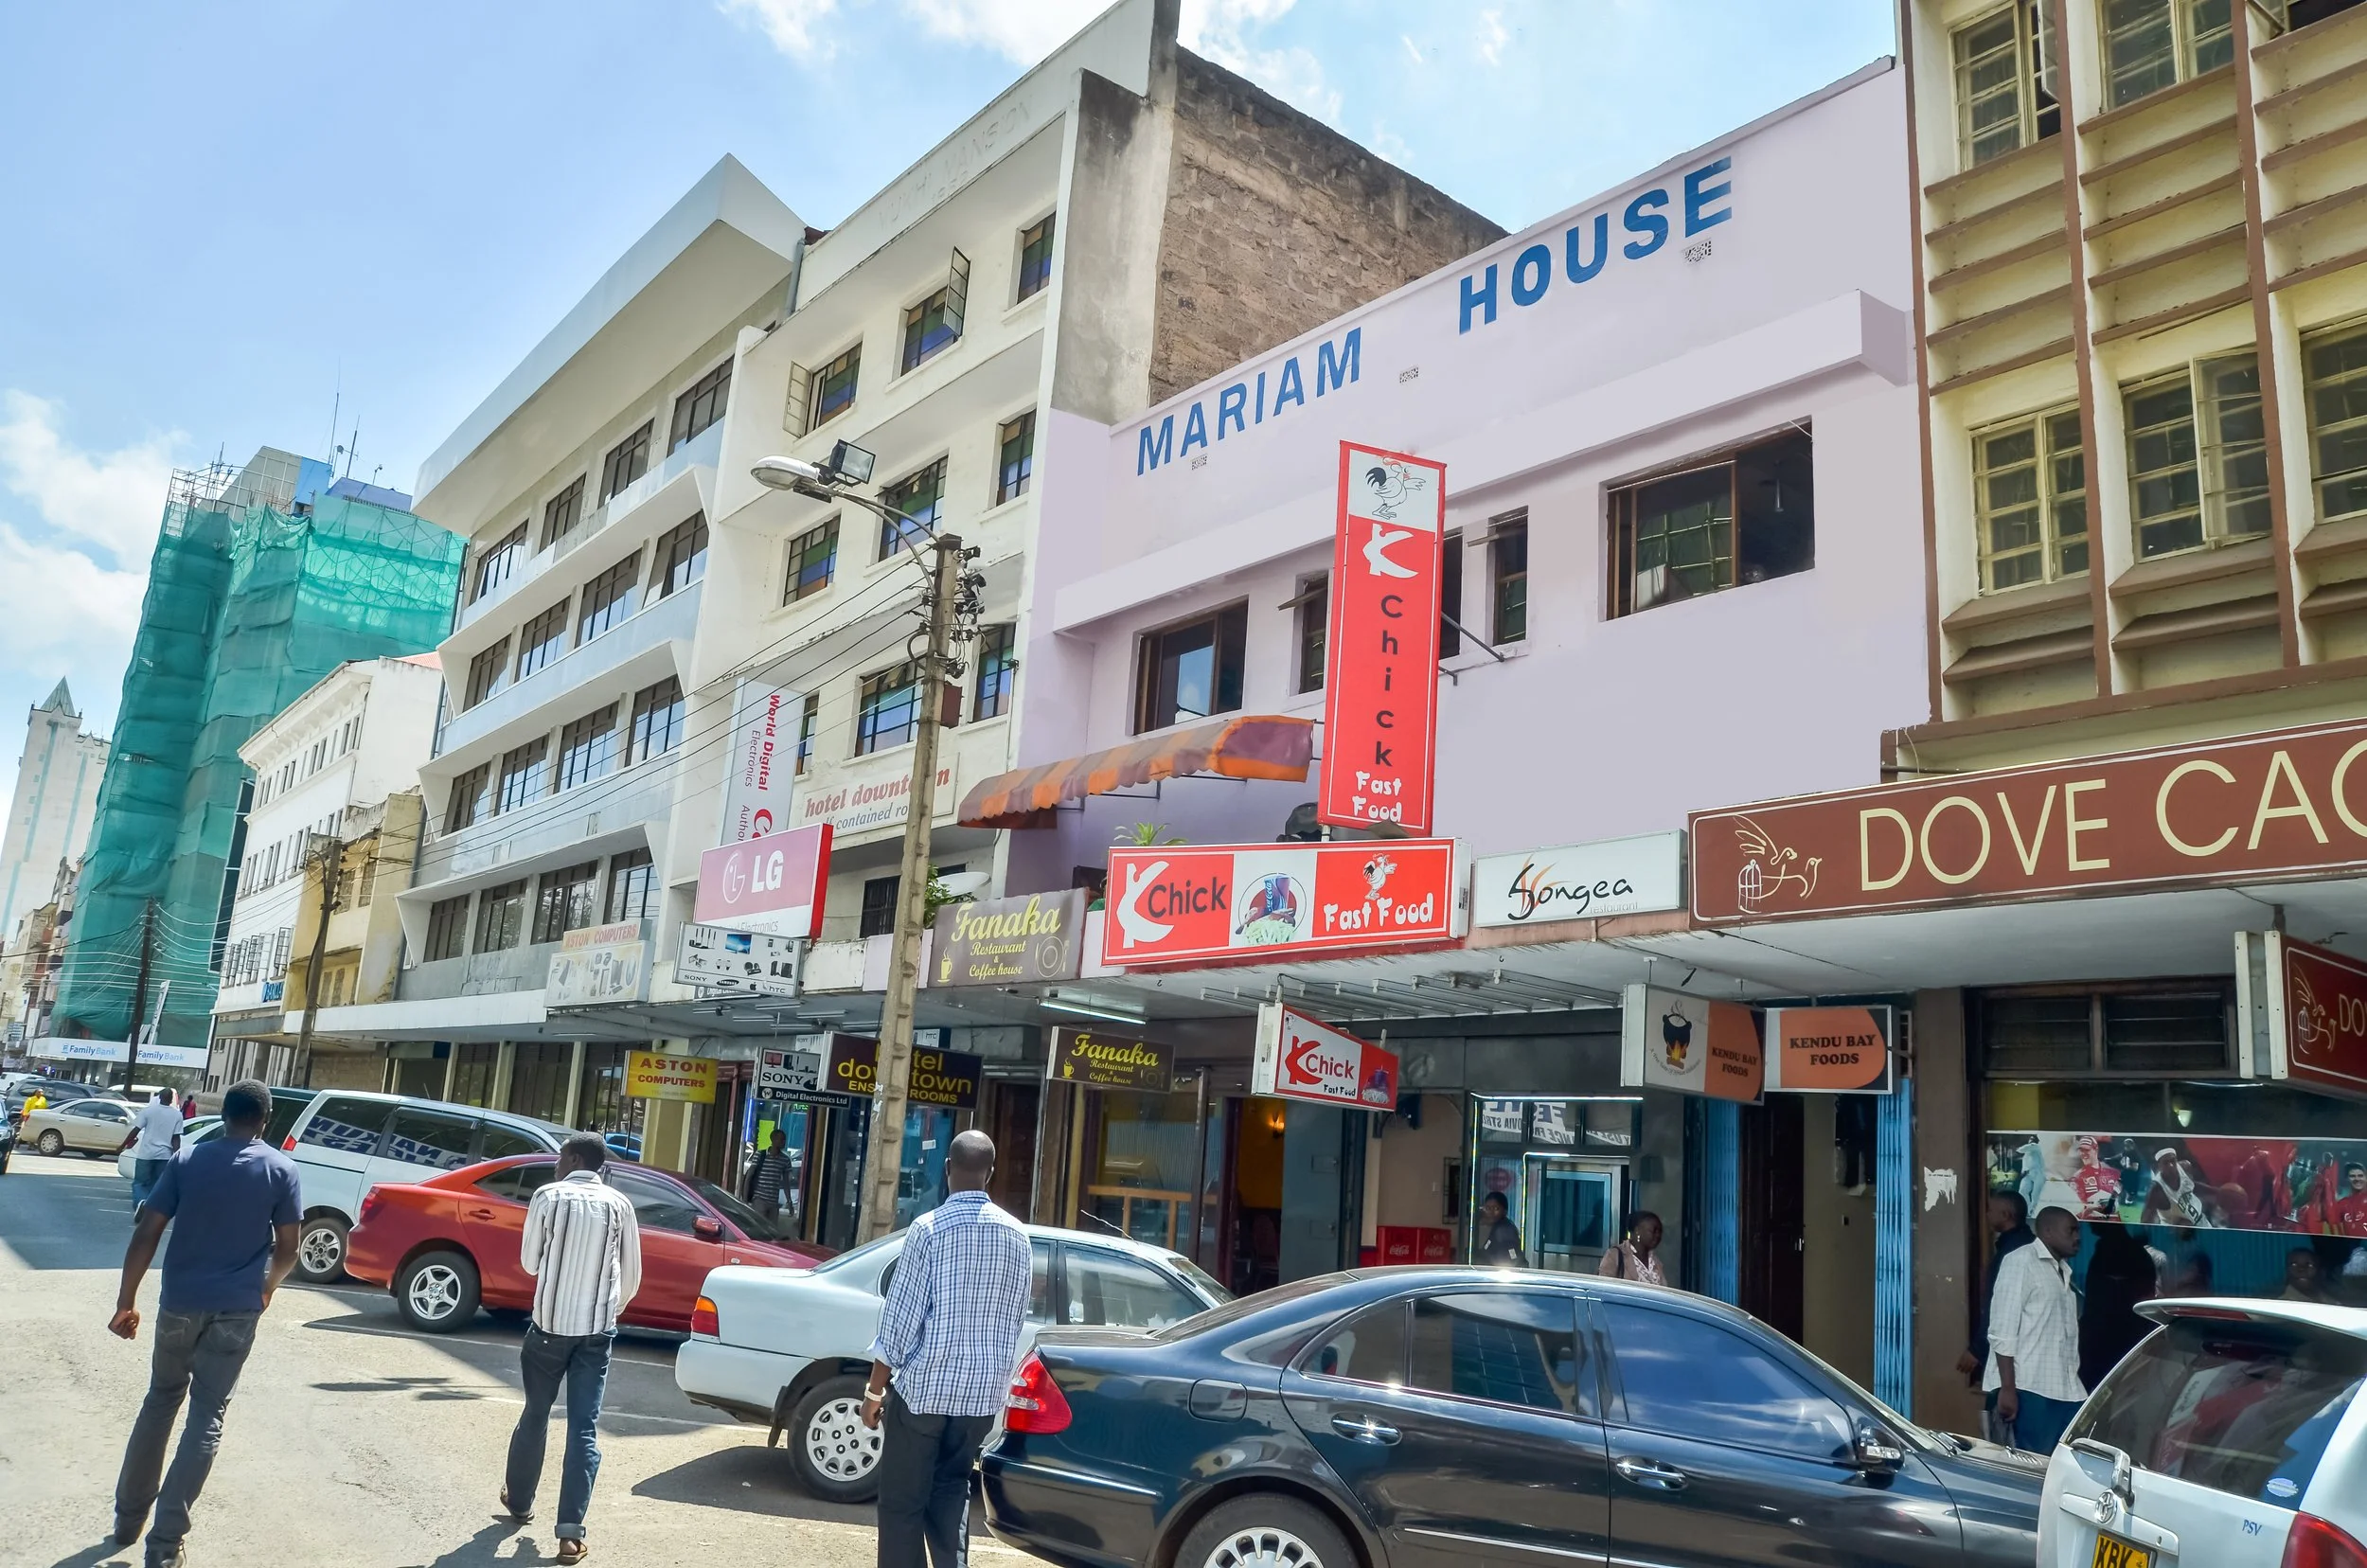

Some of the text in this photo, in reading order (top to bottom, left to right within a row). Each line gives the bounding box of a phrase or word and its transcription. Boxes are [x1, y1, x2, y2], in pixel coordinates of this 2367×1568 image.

[1137, 156, 1732, 475] MARIAM HOUSE
[757, 694, 781, 792] World Digital
[745, 729, 761, 788] Electronics
[805, 767, 951, 818] hotel downtn
[1355, 771, 1403, 797] Fast
[836, 802, 891, 830] contained
[1352, 796, 1403, 823] Food
[1860, 778, 2110, 891] DOVE
[752, 850, 785, 894] LG
[1147, 875, 1228, 919] Chick
[1508, 863, 1633, 921] Songea
[951, 893, 1061, 942] Fanaka
[1323, 900, 1372, 933] Fast
[1376, 892, 1435, 927] Food
[1590, 901, 1638, 915] restaurant
[565, 924, 637, 948] ASTON COMPUTERS
[970, 940, 1026, 956] Restaurant
[969, 962, 1023, 981] Coffee house
[2339, 993, 2367, 1038] DO
[69, 1044, 116, 1056] Family Bank
[1071, 1033, 1159, 1067] Fanaka
[1789, 1034, 1878, 1049] KENDU BAY
[137, 1049, 185, 1061] Family Bank
[1711, 1046, 1741, 1061] KENDU
[1742, 1053, 1758, 1066] BAY
[1809, 1053, 1860, 1065] FOODS
[639, 1057, 707, 1075] ASTON
[1089, 1060, 1134, 1073] Restaurant
[1305, 1053, 1355, 1080] Chick
[1721, 1062, 1749, 1078] FOODS
[637, 1075, 705, 1088] COMPUTERS
[761, 1071, 805, 1086] SONY
[1089, 1072, 1132, 1085] Coffee house
[775, 1090, 802, 1102] Digital
[803, 1093, 836, 1103] Electronics
[836, 1096, 847, 1105] Ltd
[909, 1089, 958, 1104] ROOMS
[1324, 1084, 1357, 1097] Fast Food
[2242, 1519, 2263, 1535] PSV
